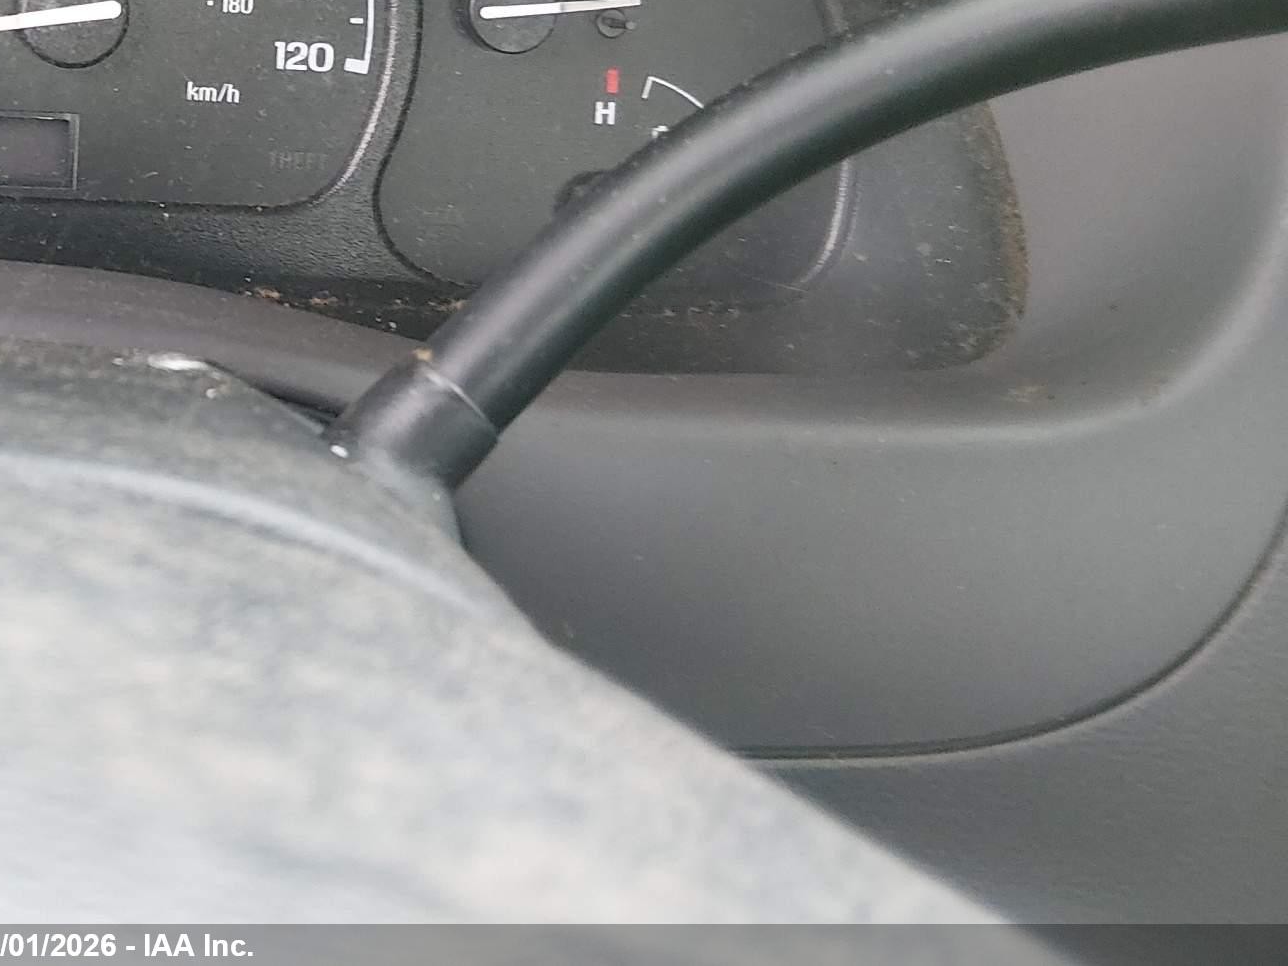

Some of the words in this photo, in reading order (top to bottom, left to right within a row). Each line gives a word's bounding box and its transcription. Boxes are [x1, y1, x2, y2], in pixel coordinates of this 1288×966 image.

[274, 41, 334, 72] 120
[186, 81, 240, 104] km/h
[594, 101, 616, 125] H
